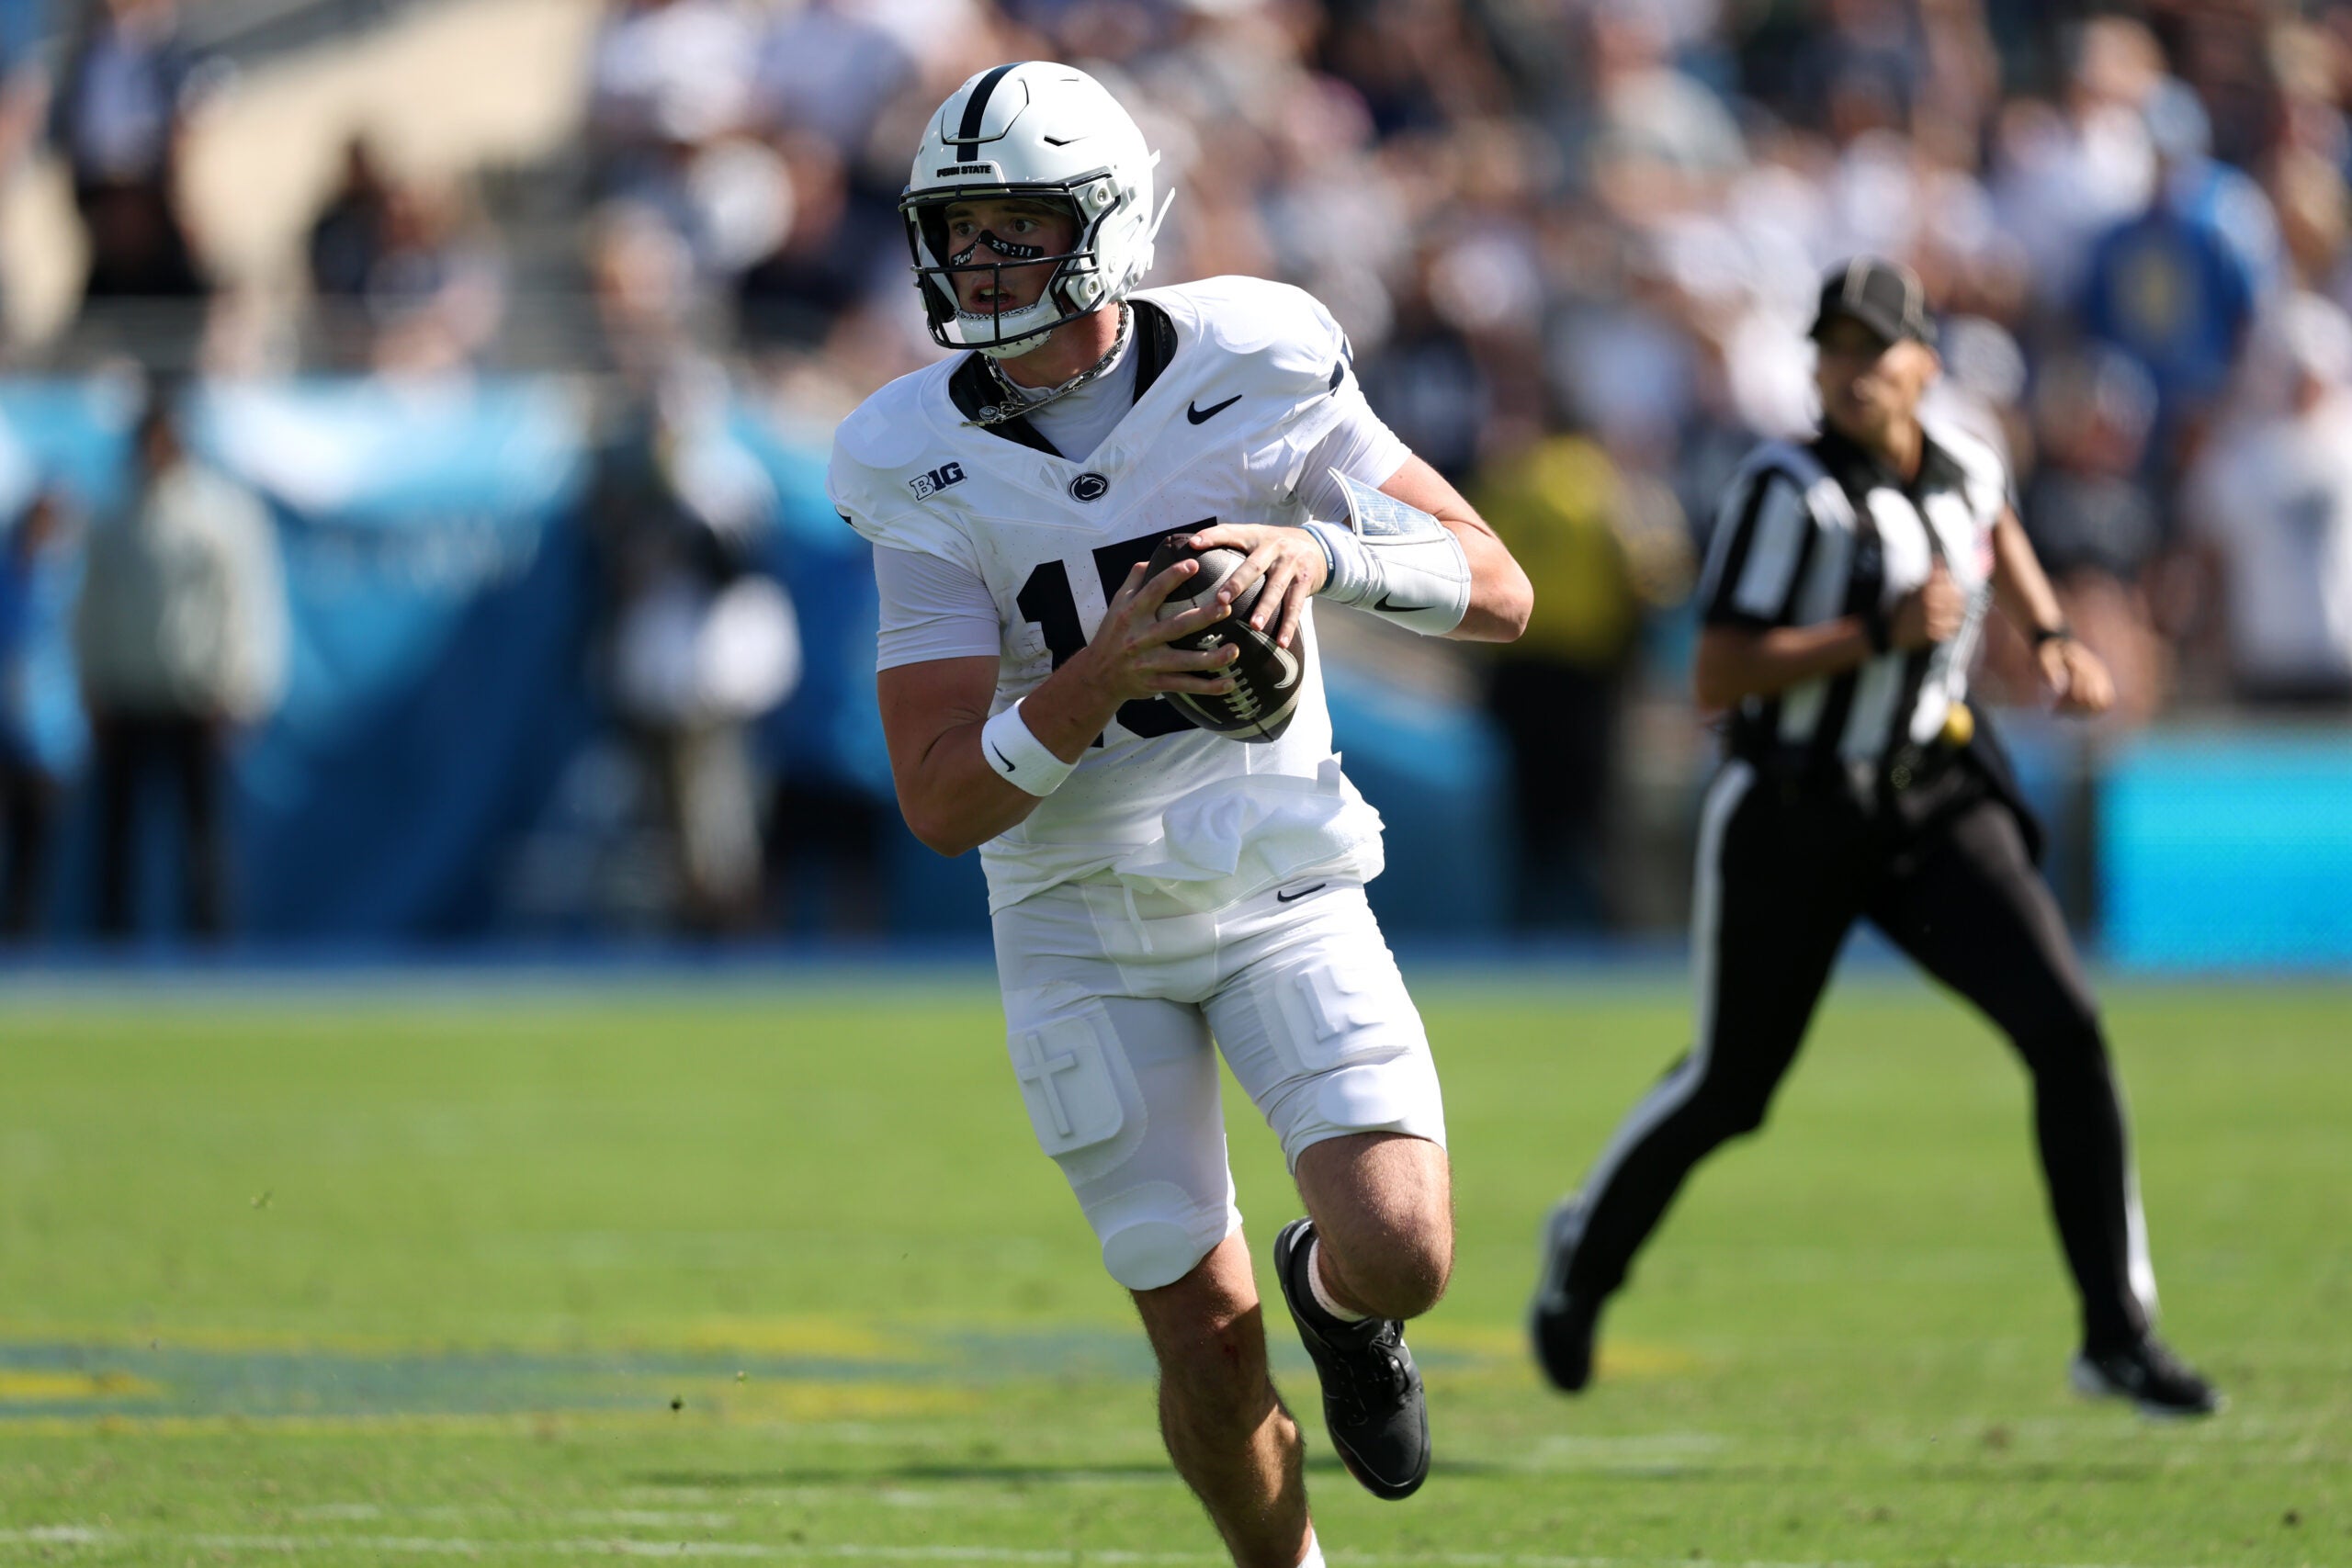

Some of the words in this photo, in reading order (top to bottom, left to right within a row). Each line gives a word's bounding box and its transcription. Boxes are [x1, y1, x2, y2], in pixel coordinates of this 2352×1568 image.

[937, 166, 960, 178] PENN
[962, 165, 992, 175] STATE
[992, 239, 1033, 257] 29:11
